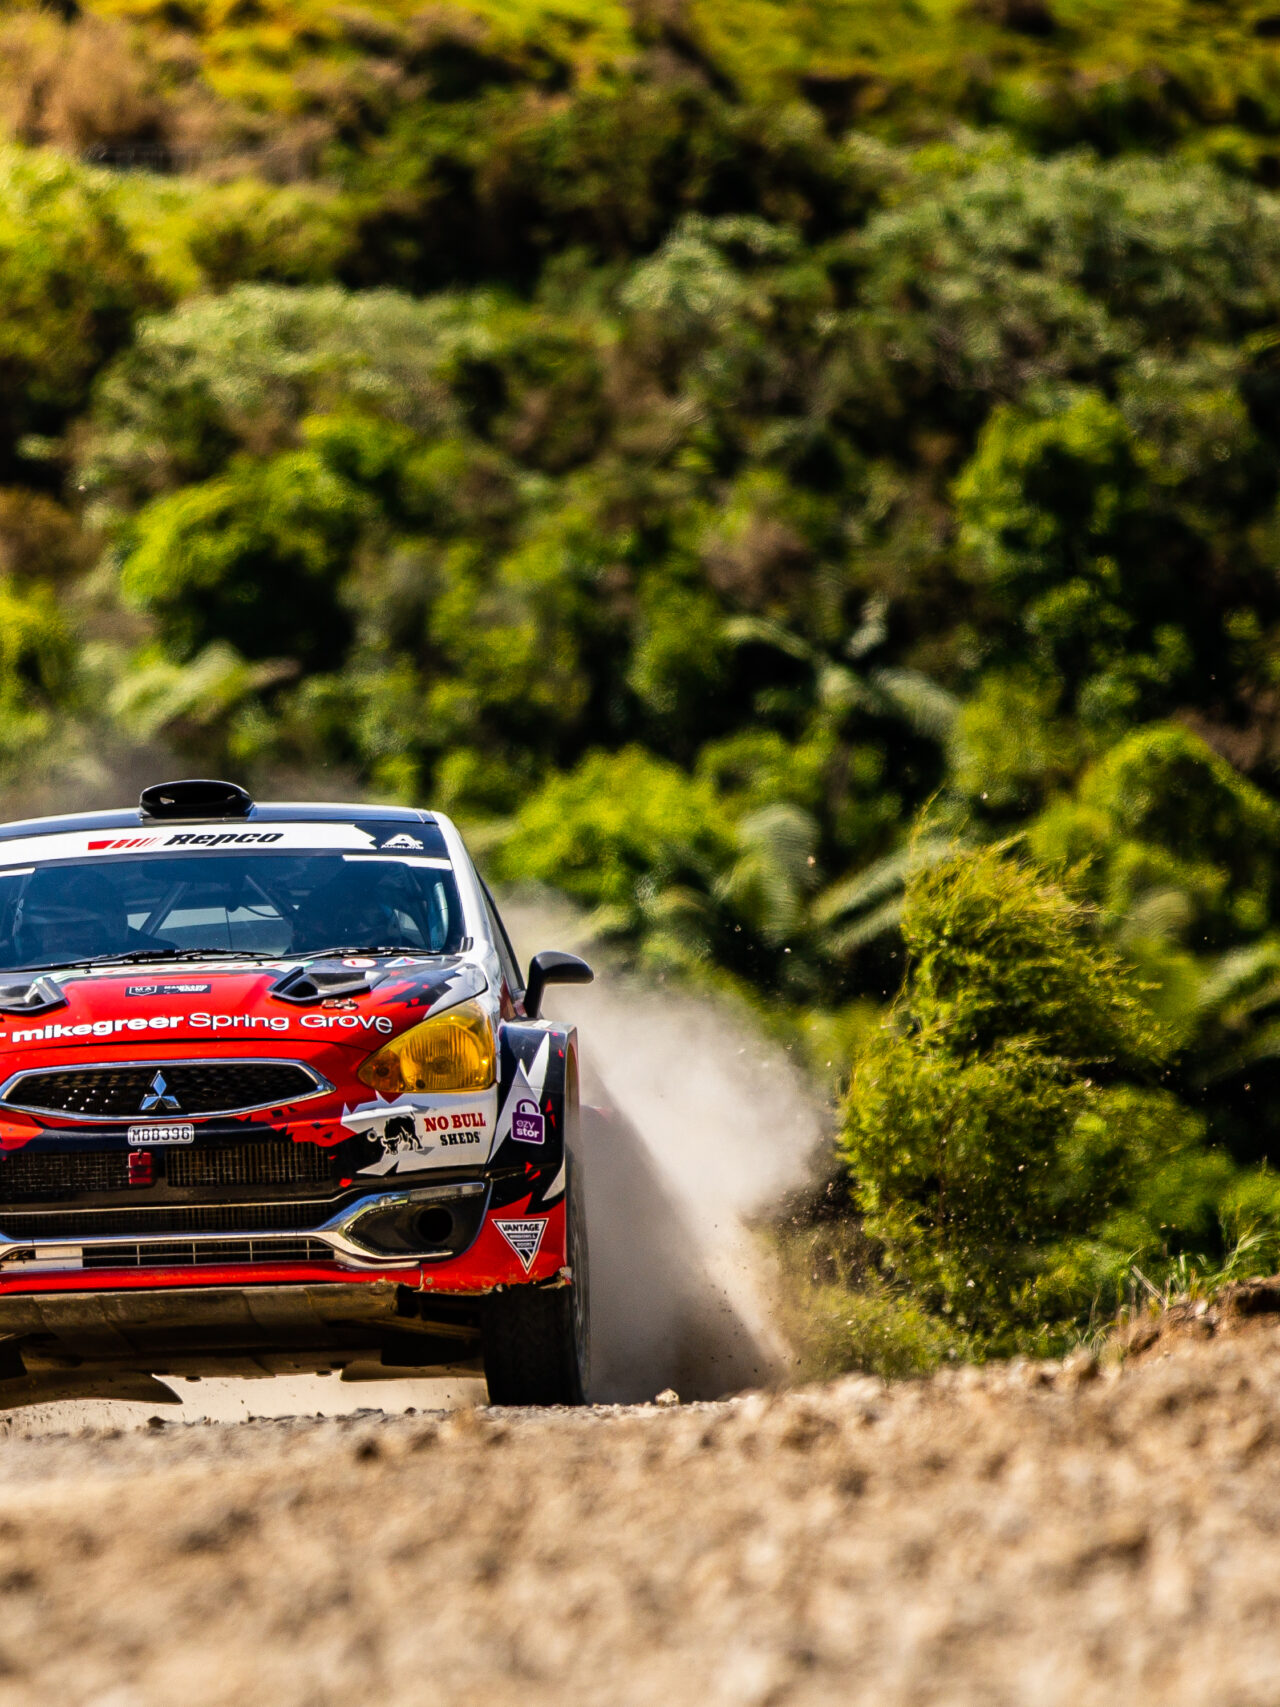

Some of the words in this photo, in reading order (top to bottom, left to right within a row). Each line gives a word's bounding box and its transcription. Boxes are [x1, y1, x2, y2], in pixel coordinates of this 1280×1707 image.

[11, 1016, 184, 1043] mikegreer
[189, 1012, 290, 1031] Spring
[299, 1014, 394, 1034] Grove
[423, 1116, 449, 1132] NO
[451, 1112, 486, 1129] BULL
[440, 1131, 480, 1146] SHEDS
[516, 1128, 539, 1139] stor
[501, 1223, 540, 1232] VANTAGE
